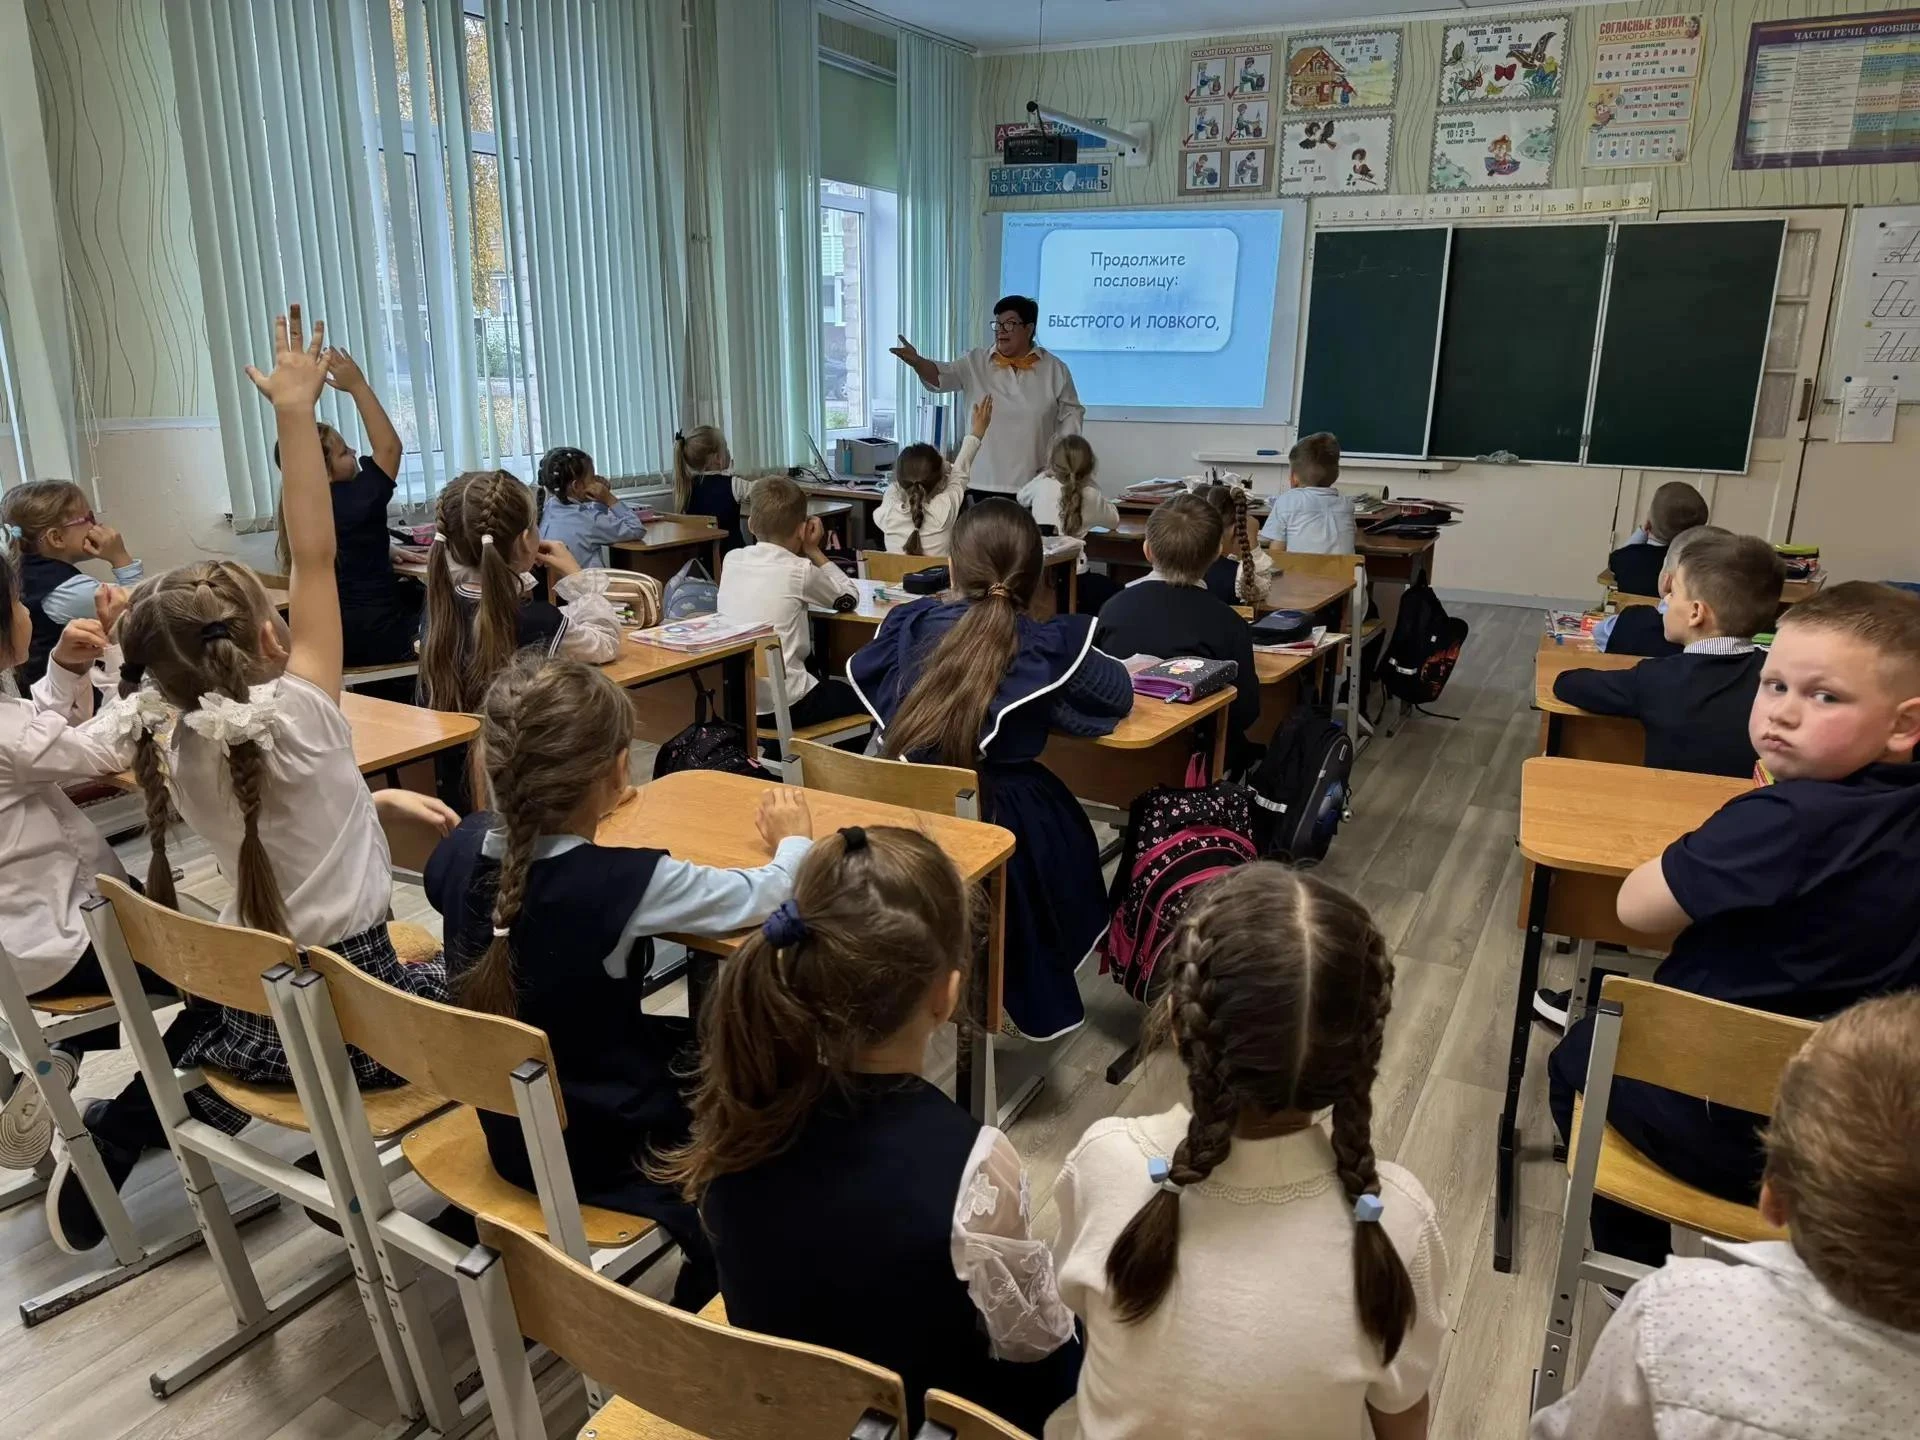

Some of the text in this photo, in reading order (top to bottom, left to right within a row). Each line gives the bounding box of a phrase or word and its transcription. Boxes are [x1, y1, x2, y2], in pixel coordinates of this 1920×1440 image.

[1600, 16, 1685, 34] СОГЛАСНЫЕ ЗВУКИ
[1599, 30, 1681, 41] РУССКОГО ЯЗЫКА
[1794, 30, 1830, 40] ЧАСТИ
[1833, 27, 1866, 38] РЕЧИ.
[1547, 204, 1556, 212] 15
[1565, 203, 1574, 211] 16
[1584, 202, 1592, 210] 17
[1602, 200, 1611, 208] 18
[1621, 199, 1630, 207] 19
[1638, 196, 1649, 205] 20
[1091, 252, 1185, 270] Продолжите
[1094, 275, 1178, 290] пословицу:
[1048, 314, 1219, 331] БЫСТРОГО И ЛОВКОГО,
